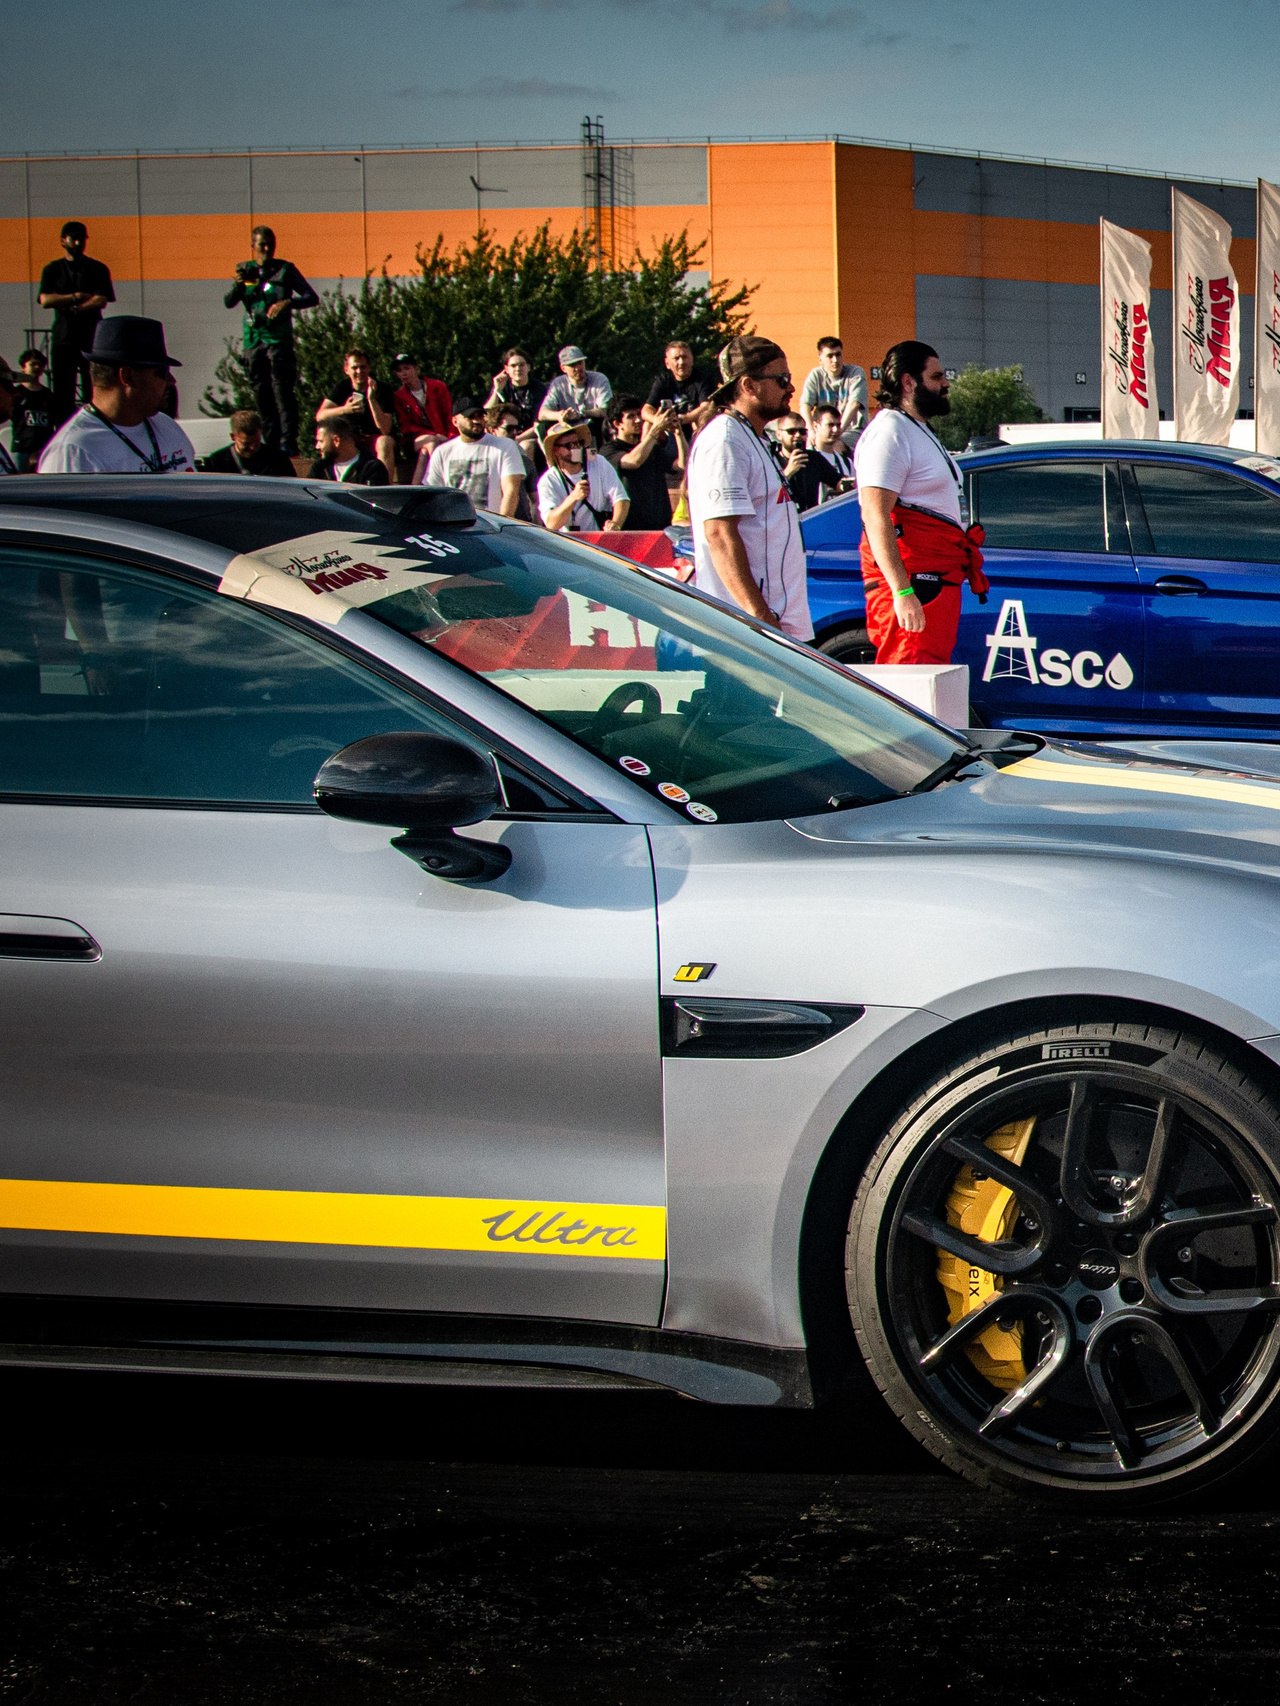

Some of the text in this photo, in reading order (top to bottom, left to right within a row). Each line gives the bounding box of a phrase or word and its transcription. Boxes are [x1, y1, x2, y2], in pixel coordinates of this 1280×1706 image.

[1206, 276, 1235, 388] Миля
[1129, 302, 1149, 409] Миля
[945, 369, 956, 379] 52
[1076, 373, 1086, 383] 54
[404, 533, 461, 557] 35
[300, 562, 391, 596] Миля
[1041, 1041, 1111, 1060] PIRELLI
[481, 1209, 638, 1247] Ultra
[968, 1265, 981, 1297] xia
[1080, 1262, 1117, 1276] Ultra
